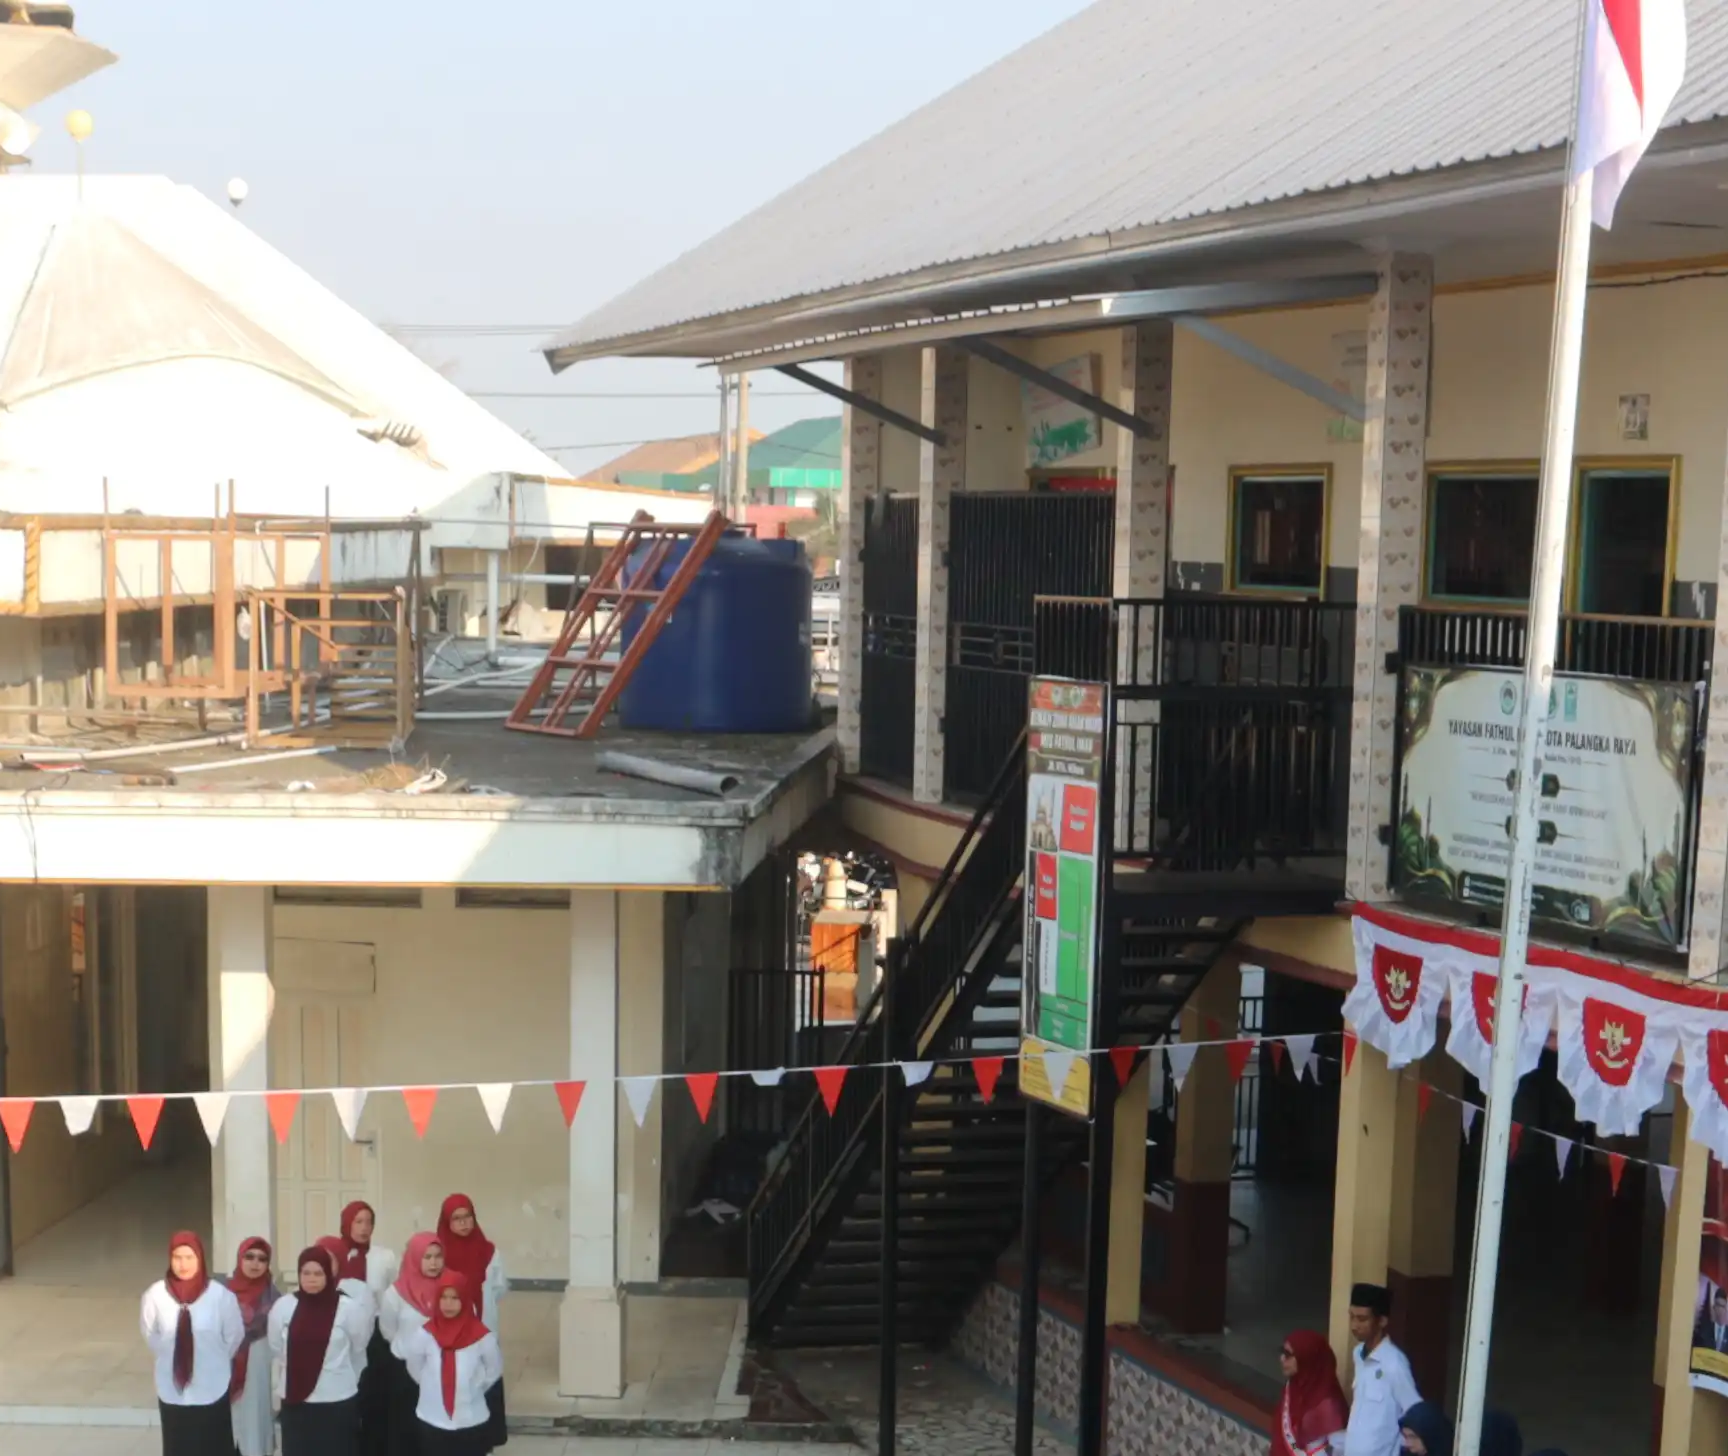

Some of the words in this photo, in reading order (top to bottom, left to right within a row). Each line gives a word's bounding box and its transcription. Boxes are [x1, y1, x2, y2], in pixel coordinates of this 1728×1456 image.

[1448, 719, 1484, 738] YAYASAN
[1485, 722, 1514, 742] FATHUL
[1565, 733, 1610, 751] PALANGKA
[1613, 738, 1636, 756] RAYA
